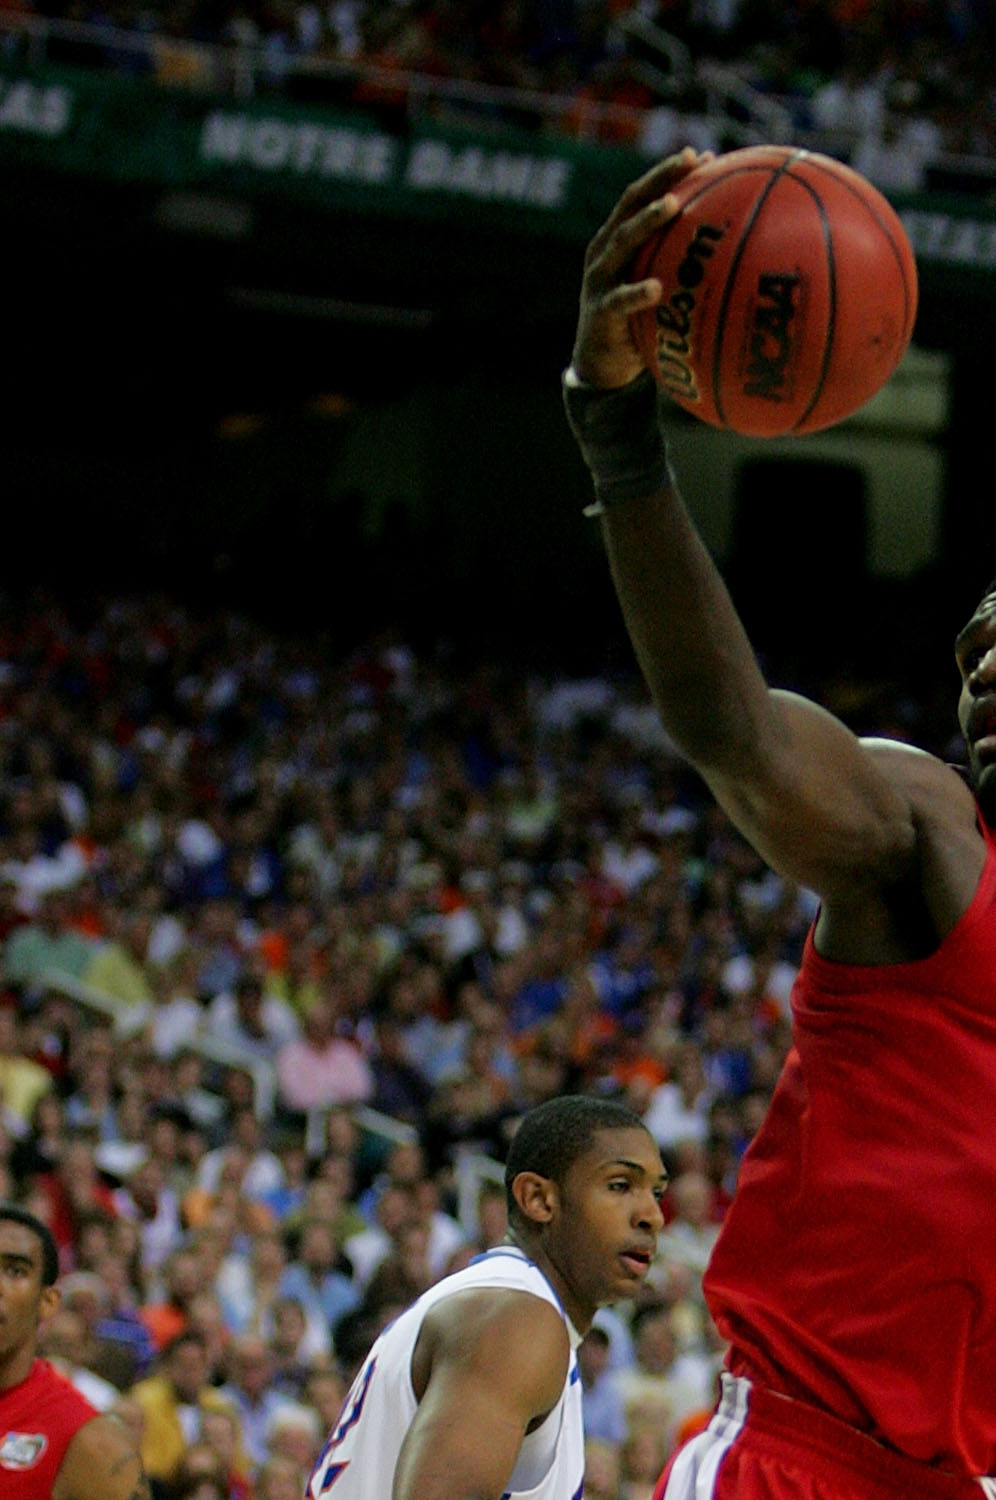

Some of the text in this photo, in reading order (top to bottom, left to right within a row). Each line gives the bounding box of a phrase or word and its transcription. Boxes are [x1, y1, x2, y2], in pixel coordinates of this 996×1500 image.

[203, 110, 572, 208] NOTRE DAME
[655, 224, 725, 403] Wilson
[744, 269, 806, 403] NCAA
